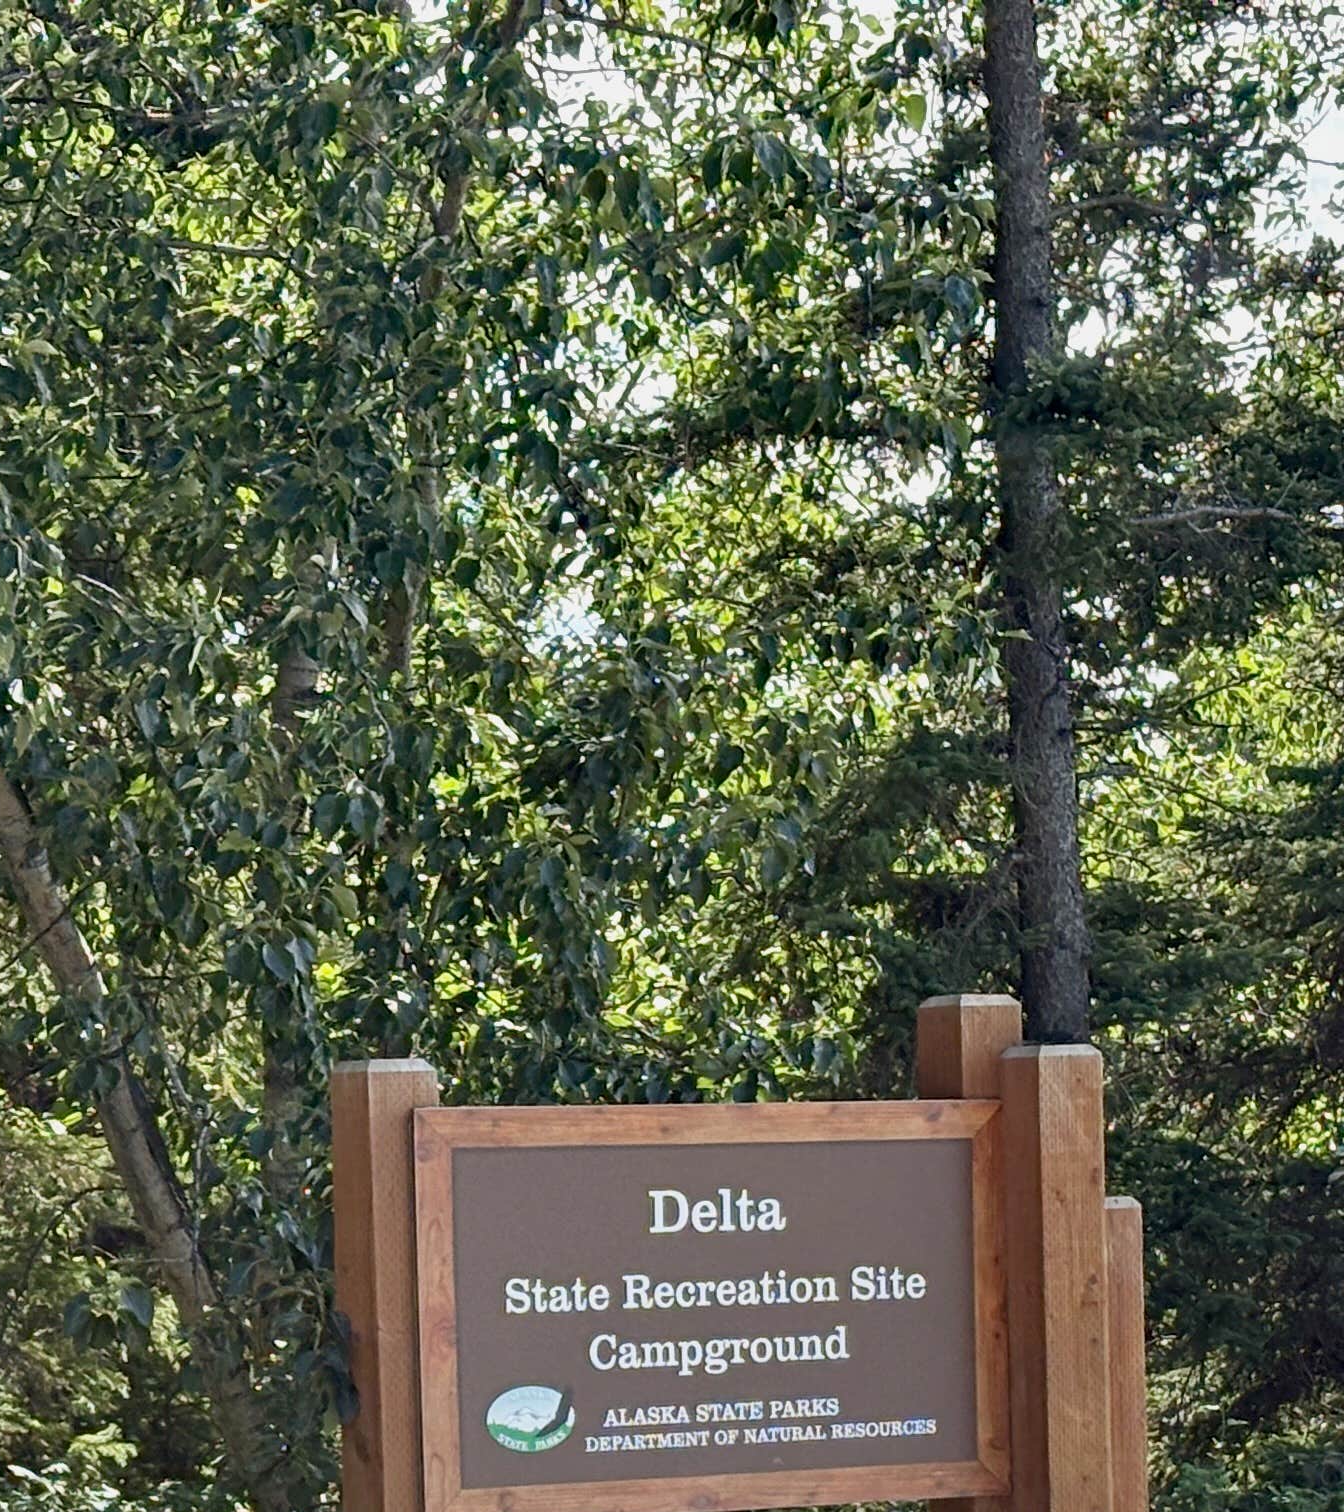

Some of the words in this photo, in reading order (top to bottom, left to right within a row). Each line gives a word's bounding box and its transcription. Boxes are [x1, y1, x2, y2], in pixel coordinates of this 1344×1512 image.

[648, 1188, 787, 1234] Delta
[505, 1276, 610, 1314] State
[621, 1269, 840, 1310] Recreation
[851, 1265, 927, 1301] Site
[589, 1325, 851, 1377] Campground
[602, 1405, 691, 1428] ALASKA
[695, 1400, 764, 1423] STATE
[768, 1397, 840, 1420] PARKS
[496, 1433, 529, 1452] STATE
[535, 1430, 566, 1450] PARKS
[584, 1430, 711, 1453] DEPARTMENT
[713, 1429, 740, 1446] OF
[743, 1424, 827, 1445] NATURAL
[830, 1418, 937, 1440] RESOURCES
